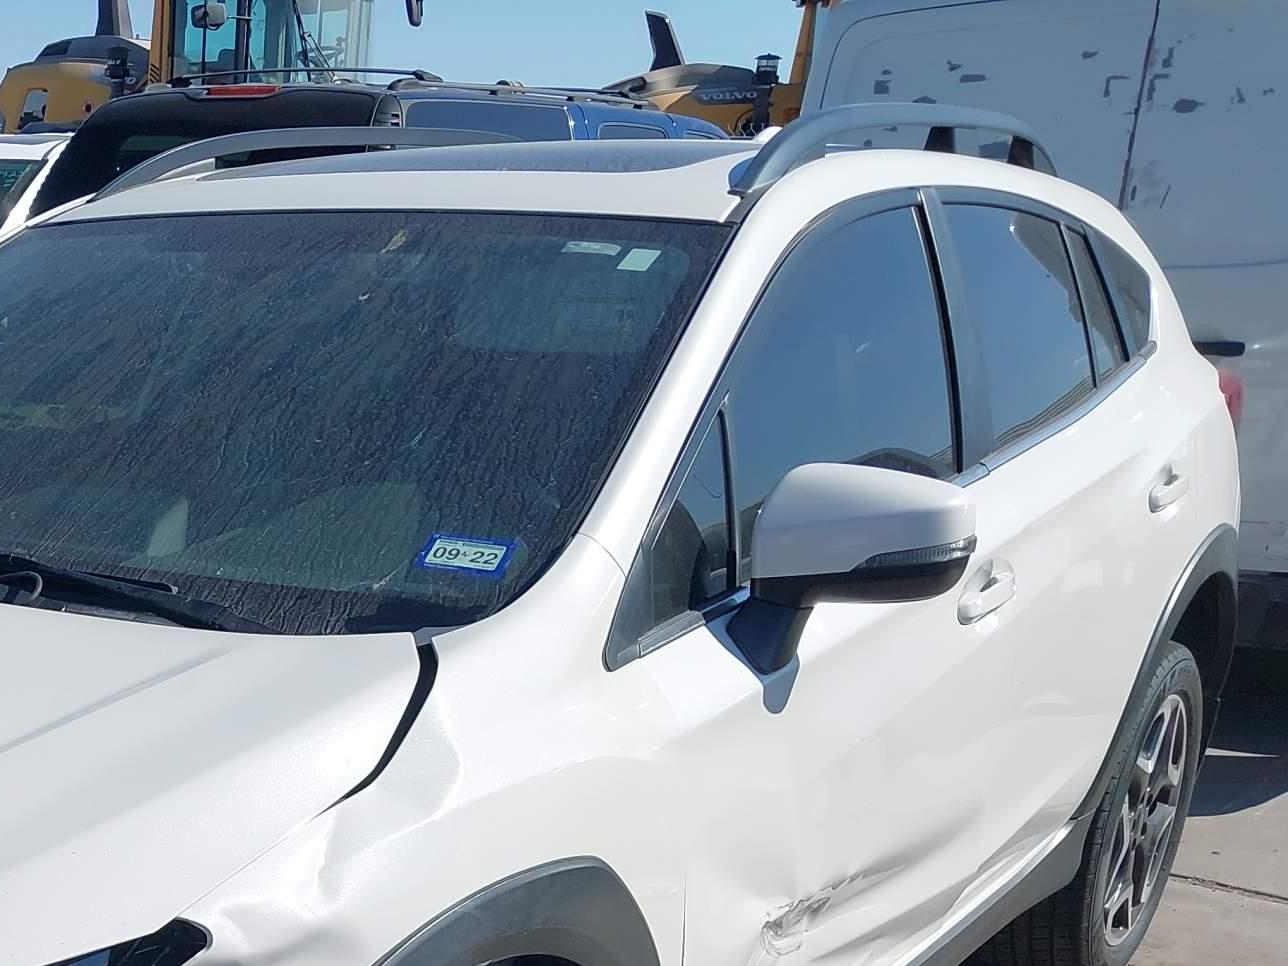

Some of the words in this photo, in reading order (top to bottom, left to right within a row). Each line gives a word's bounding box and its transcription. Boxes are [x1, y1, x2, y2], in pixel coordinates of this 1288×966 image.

[700, 90, 758, 101] VOLVO
[432, 546, 461, 561] 09
[468, 550, 499, 565] 22
